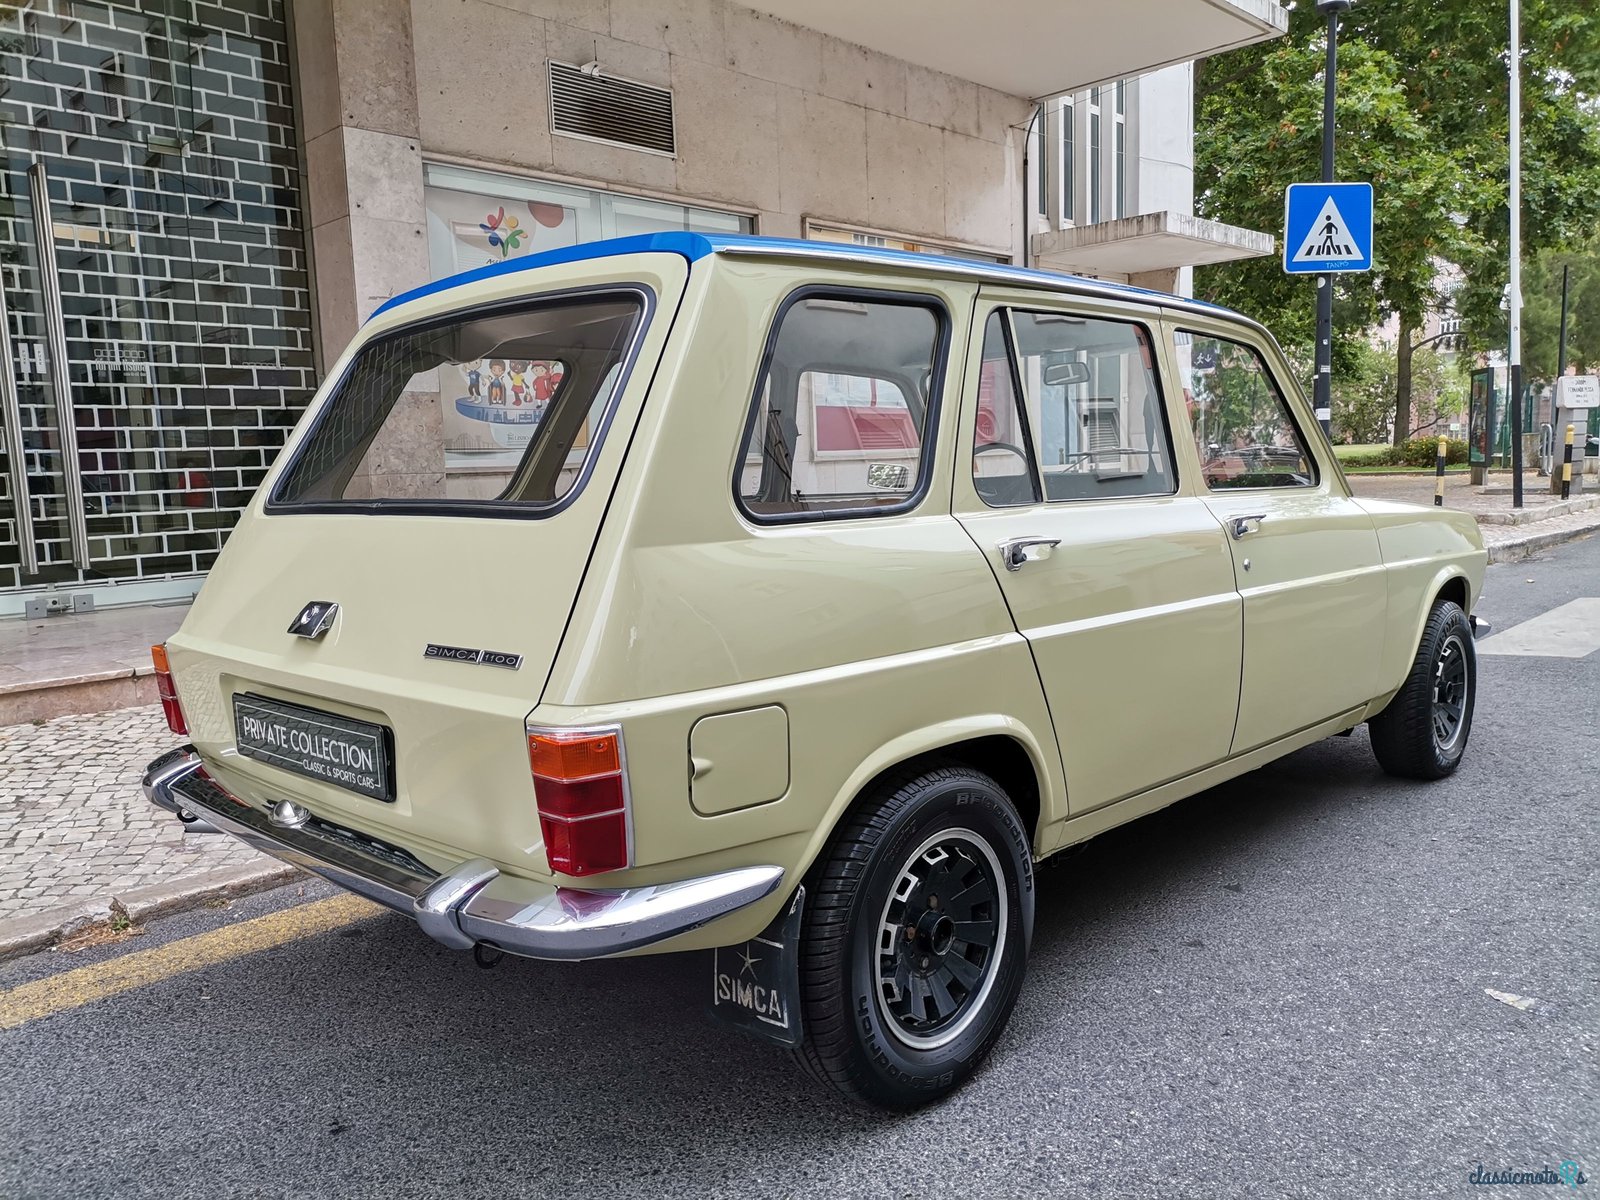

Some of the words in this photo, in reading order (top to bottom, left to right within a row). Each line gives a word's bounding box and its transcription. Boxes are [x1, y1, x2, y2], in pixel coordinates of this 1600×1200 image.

[426, 646, 477, 661] SIMCA
[485, 653, 516, 665] 1100
[243, 715, 288, 749] PRIVATE
[290, 729, 373, 772] COLLECTION
[303, 759, 326, 775] CLASSIC
[327, 767, 332, 777] &
[333, 768, 356, 785] SPORTS
[357, 775, 375, 789] CARS
[718, 973, 782, 1019] SIMCA
